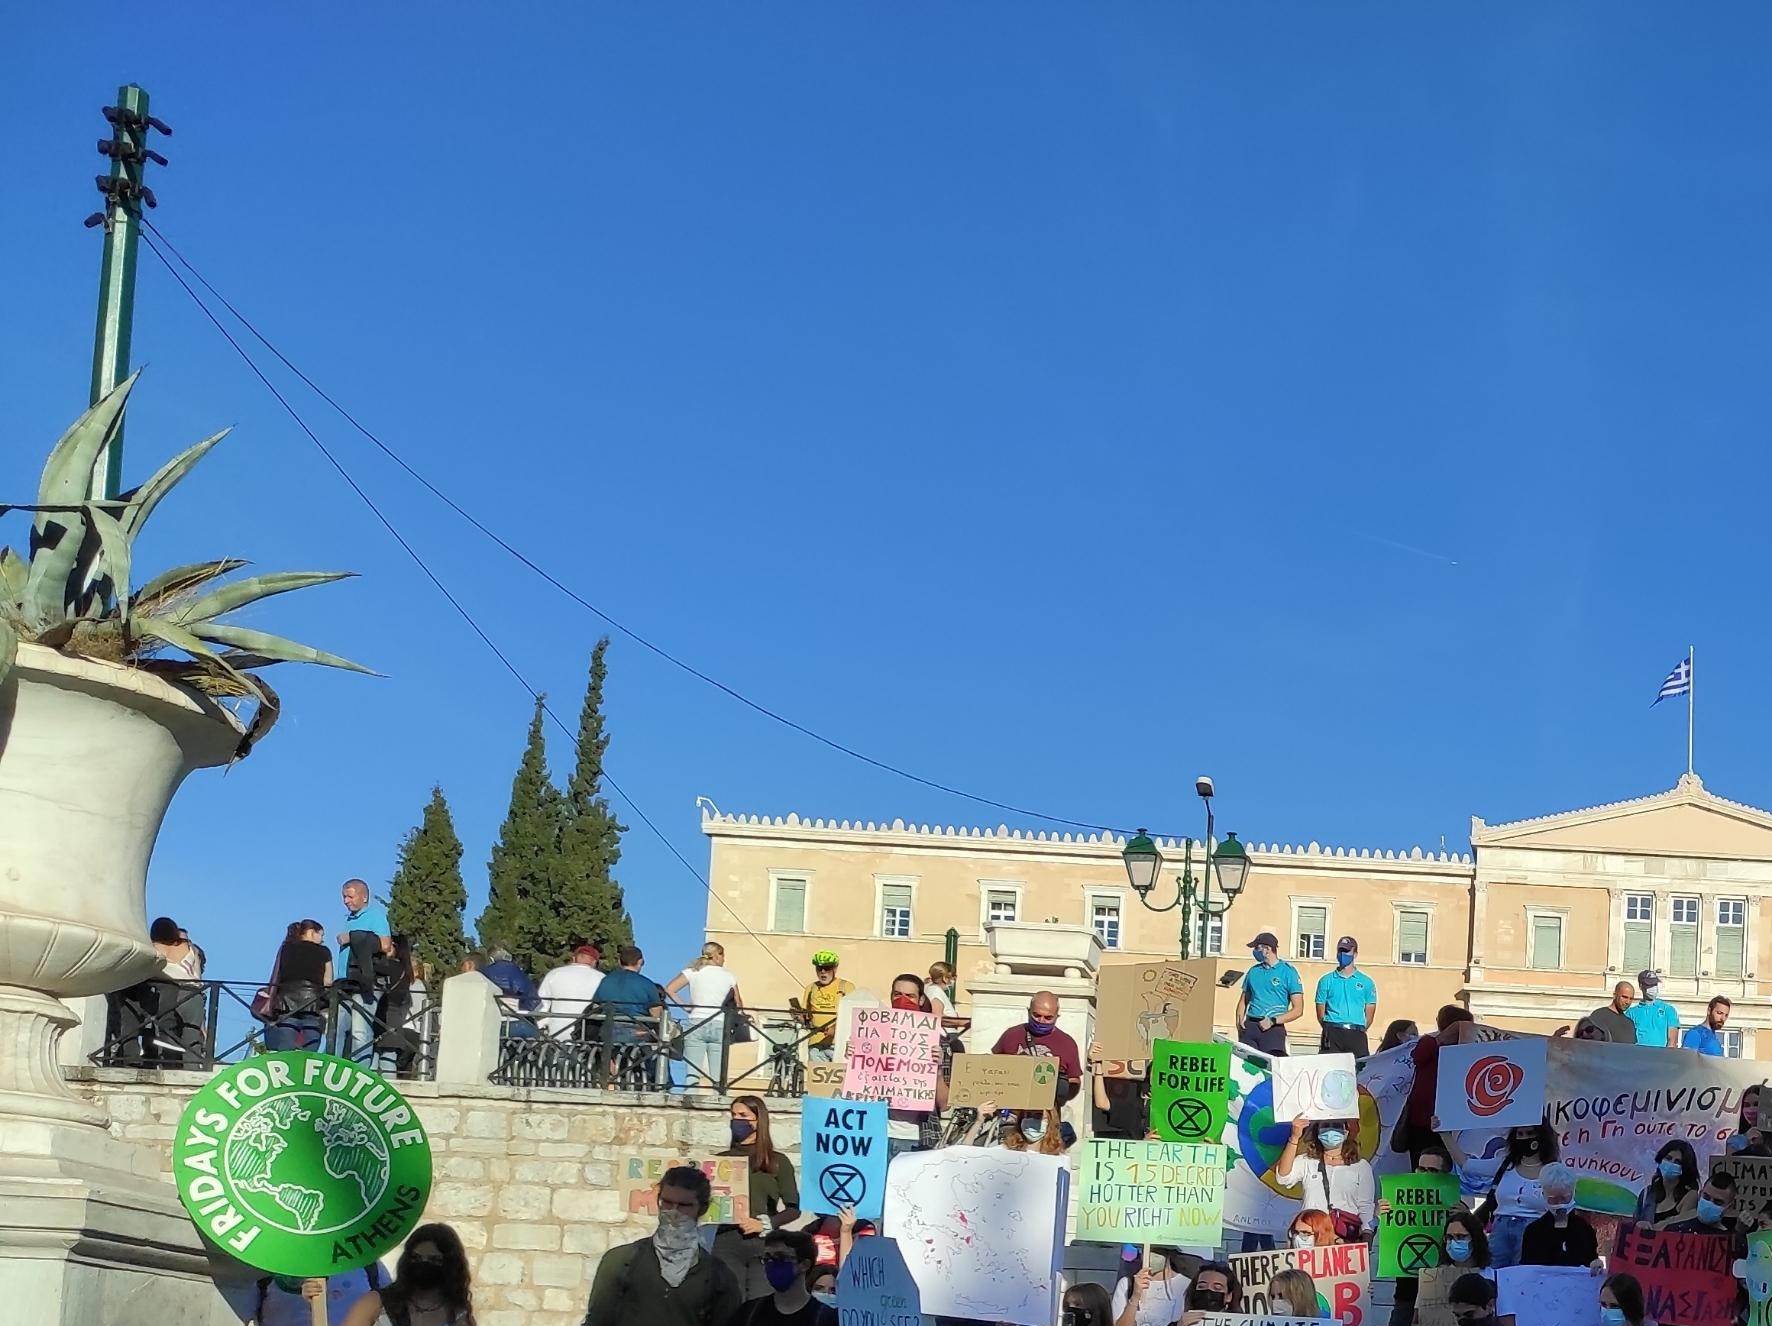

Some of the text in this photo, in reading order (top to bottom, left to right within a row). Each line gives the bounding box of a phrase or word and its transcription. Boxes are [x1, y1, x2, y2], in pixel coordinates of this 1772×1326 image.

[858, 1009, 938, 1030] ΦΟΒΑΜΑΙ
[857, 1026, 929, 1046] ΓΙΑ ΤΟΥΣ
[880, 1042, 929, 1060] ΝΕΟΥΣ
[851, 1055, 937, 1074] ΠΟΛΕΜΟΥΣ
[1169, 1054, 1217, 1074] REBEL
[812, 1066, 847, 1084] SYS
[1158, 1073, 1225, 1093] FOR LIFE
[824, 1107, 868, 1131] ACT
[184, 1058, 423, 1252] FRIDAYS FOR FUTURE
[815, 1132, 873, 1157] NOW
[1089, 1140, 1218, 1165] THE EARTH
[1095, 1161, 1225, 1187] IS DEGREES
[1090, 1184, 1214, 1203] HOTTER THAN
[1396, 1188, 1443, 1206] REBEL
[331, 1184, 421, 1264] ATHENS
[1082, 1206, 1122, 1230] YOU
[1124, 1207, 1174, 1228] RIGHT
[1179, 1207, 1222, 1227] NOW
[1386, 1209, 1417, 1227] FOR
[849, 1255, 885, 1289] WHICH
[1298, 1244, 1368, 1279] PLANET
